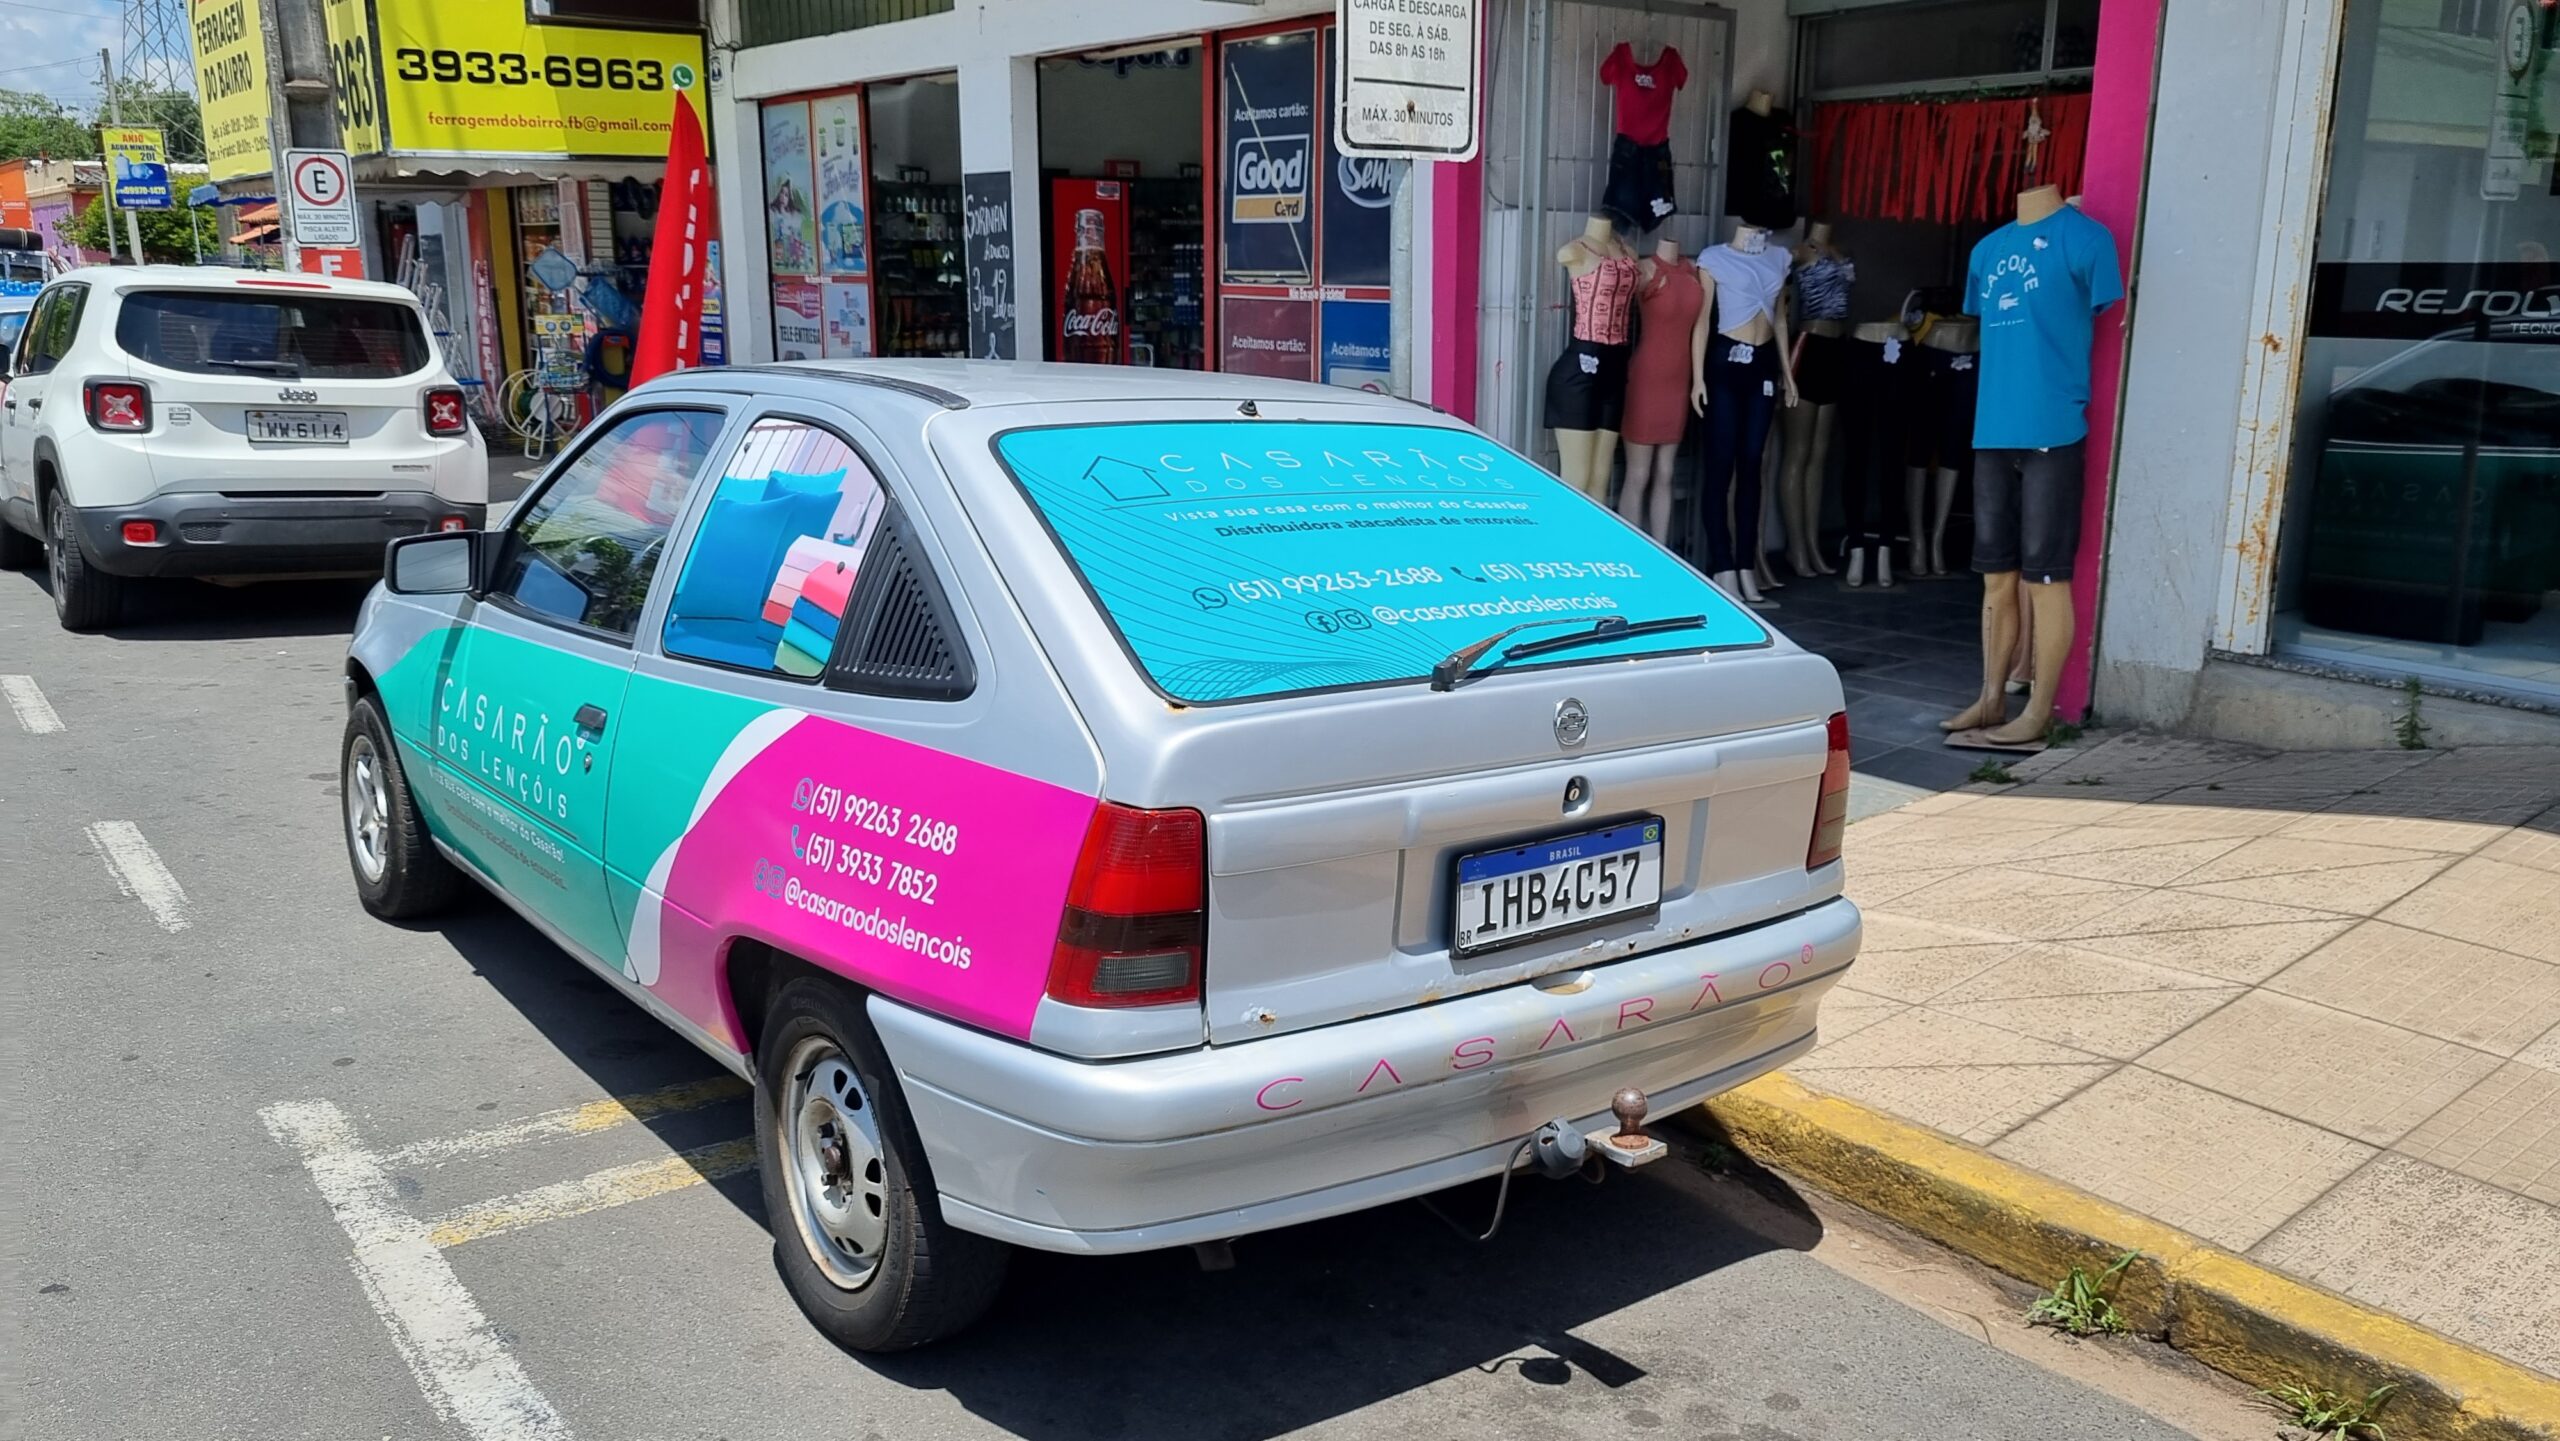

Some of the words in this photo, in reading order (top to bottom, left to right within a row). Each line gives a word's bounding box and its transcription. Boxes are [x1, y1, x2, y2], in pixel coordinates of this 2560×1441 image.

[1354, 0, 1395, 12] CARGA
[1399, 0, 1406, 12] E
[1409, 1, 1467, 19] DESCARGA
[196, 0, 247, 57] FERRAGEM
[1370, 21, 1385, 35] DE
[1388, 23, 1414, 38] SEG.
[1427, 25, 1451, 42] SÁB.
[1370, 41, 1393, 56] DAS
[1396, 44, 1408, 57] 8h
[1411, 45, 1425, 58] AS
[1429, 47, 1445, 61] 18h
[204, 65, 218, 104] DO
[217, 50, 252, 98] BAIRRO
[397, 48, 664, 91] 3933-6963
[428, 112, 671, 133] ferragemdobairro.fb@gmail.com
[1234, 107, 1277, 122] Aceitamos
[1278, 102, 1309, 118] cartão:
[1362, 104, 1391, 122] MÁX.
[1394, 109, 1406, 123] 30
[1409, 110, 1454, 126] MINUTOS
[1239, 150, 1303, 190] Good
[313, 170, 328, 194] E
[1274, 201, 1300, 217] Card
[1981, 254, 2039, 299] LACOSTE
[1064, 308, 1118, 337] Coca-Cola
[1232, 335, 1275, 351] Aceitamos
[1276, 338, 1306, 353] cartão:
[1331, 342, 1381, 358] Aceitamos
[278, 387, 318, 403] Jeep
[1185, 475, 1284, 493] DOS
[1320, 473, 1514, 489] LENÇÓIS
[1164, 510, 1219, 522] Vista
[1224, 507, 1259, 517] sua
[1264, 504, 1307, 515] casa
[1311, 502, 1352, 512] com
[1356, 502, 1369, 511] o
[1372, 499, 1434, 510] melhor
[1438, 500, 1460, 510] do
[1214, 519, 1344, 537] Distribuidora
[1345, 516, 1439, 529] atacadista
[1439, 515, 1462, 526] de
[1463, 515, 1539, 527] enxovais.
[1480, 562, 1524, 583] (51)
[1525, 561, 1642, 581] 3933-7852
[1228, 576, 1281, 604] (51)
[1281, 566, 1444, 596] 99263-2688
[1372, 590, 1619, 627] @casaraodoslencois
[438, 725, 470, 761] DOS
[481, 750, 567, 819] LENÇÓIS
[456, 786, 471, 803] casa
[520, 823, 530, 841] do
[809, 783, 842, 823] (51)
[844, 794, 902, 838] 99263
[904, 813, 958, 856] 2688
[1549, 846, 1581, 862] BRASIL
[805, 832, 835, 873] (51)
[836, 844, 884, 885] 3933
[886, 861, 938, 906] 7852
[1476, 851, 1640, 934] IHB4C57
[784, 876, 972, 970] @casaraodoslencois
[1460, 930, 1472, 946] BR
